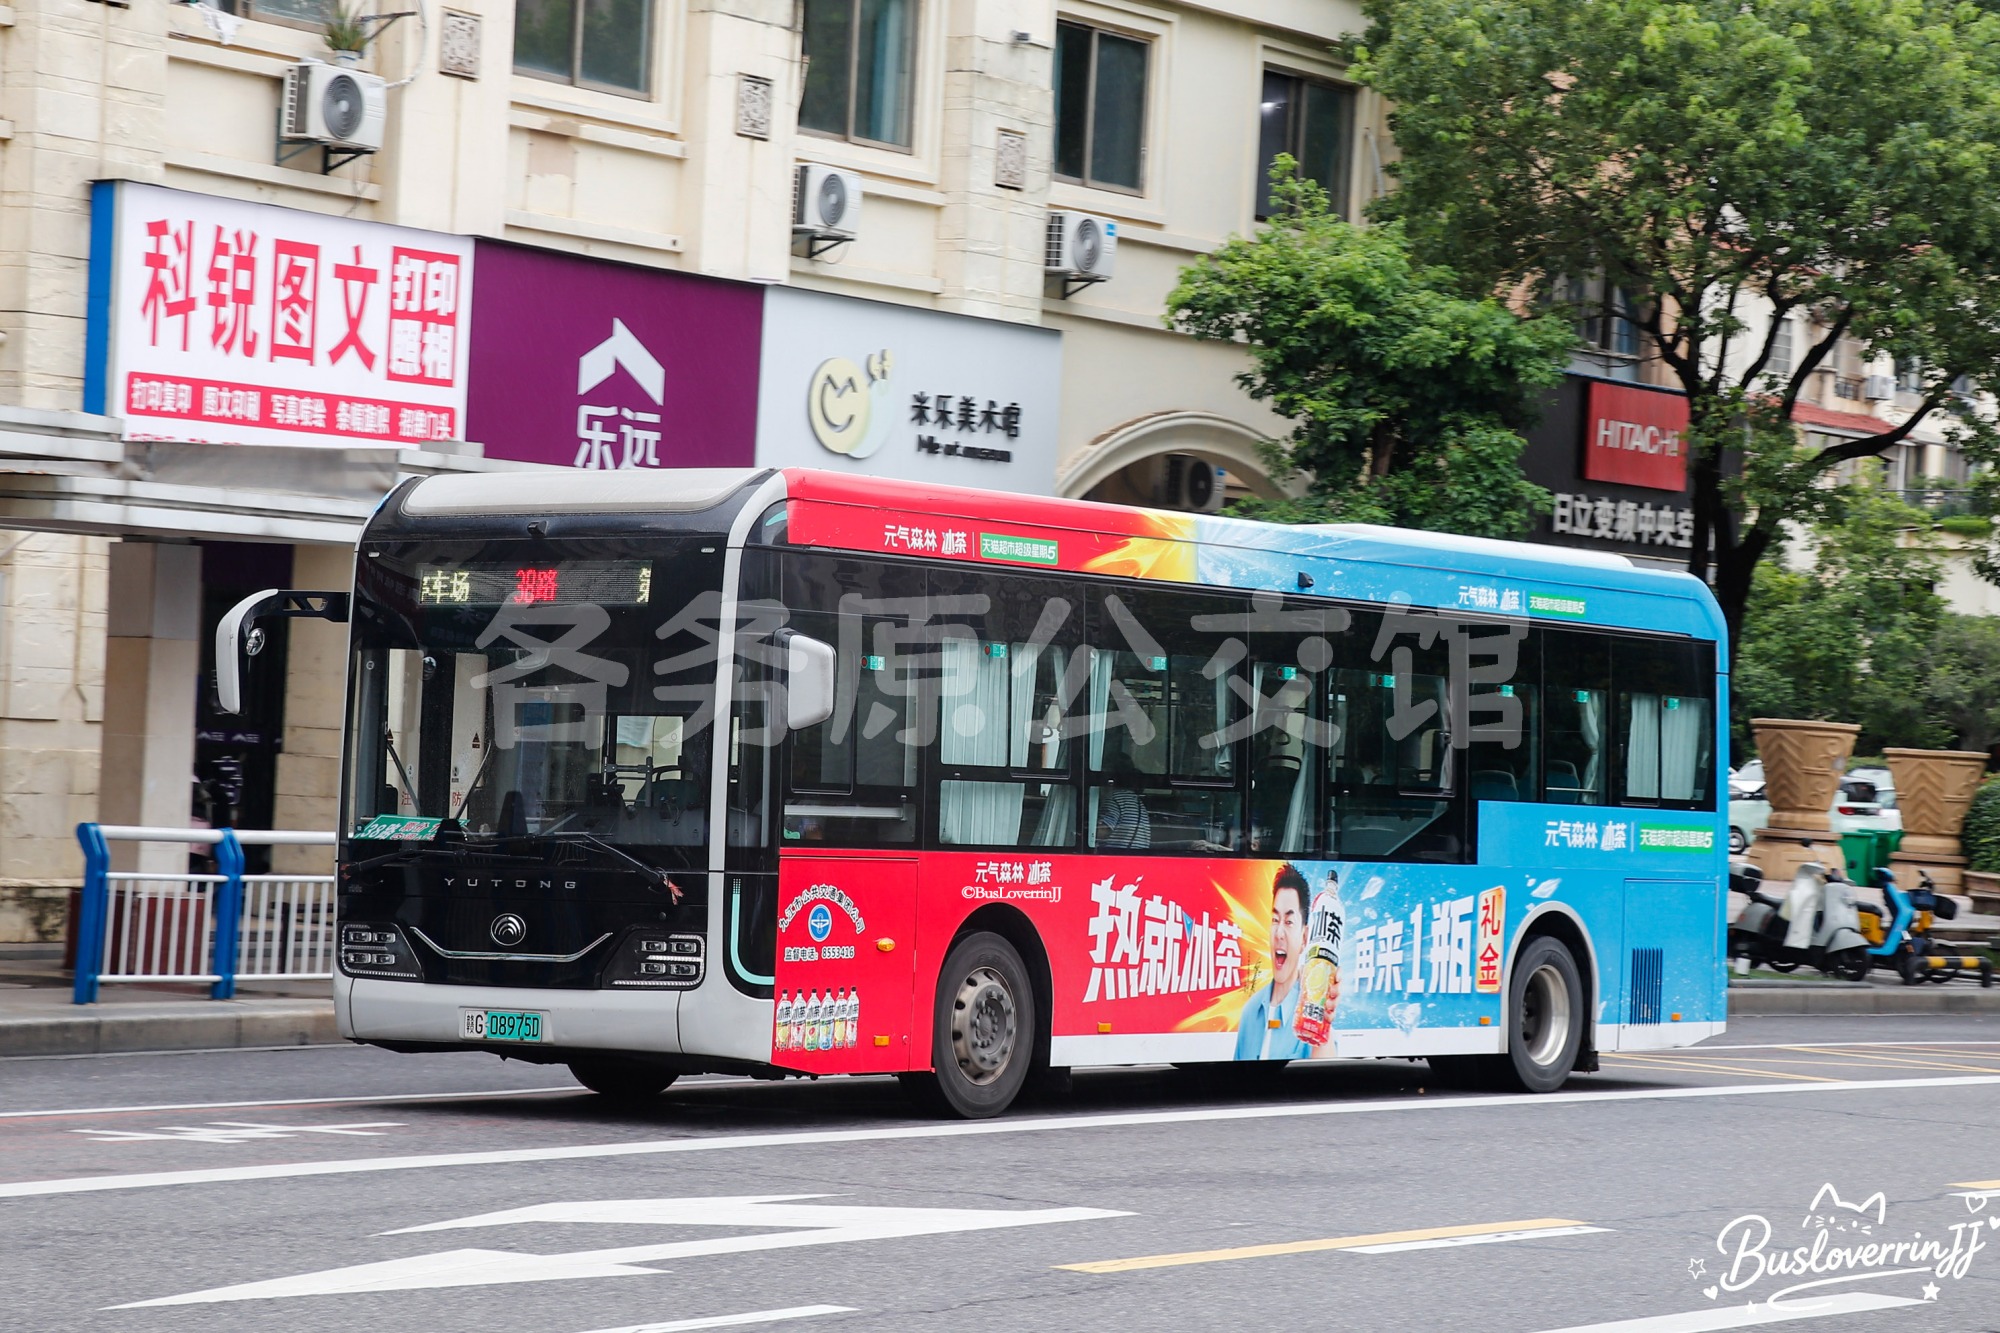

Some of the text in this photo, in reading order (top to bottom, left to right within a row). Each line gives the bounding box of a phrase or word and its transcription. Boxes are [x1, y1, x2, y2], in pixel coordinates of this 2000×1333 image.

[142, 219, 380, 372] 科锐图文
[393, 254, 458, 317] 打印
[910, 391, 1021, 438] 米乐美术馆
[884, 524, 967, 555] 元气森林 冰茶
[1553, 493, 1715, 552] 日立变频中央空
[1458, 585, 1498, 609] 元气森林
[1545, 820, 1598, 849] 元气森林
[444, 878, 576, 889] YUTONG
[975, 860, 1052, 885] 元气森林 冰茶
[779, 884, 866, 935] 九江市公共交通集团公司
[822, 946, 855, 959] 8553416
[1082, 874, 1242, 1003] 热就冰茶
[1354, 895, 1475, 994] 再来1瓶
[1480, 895, 1501, 985] 礼金
